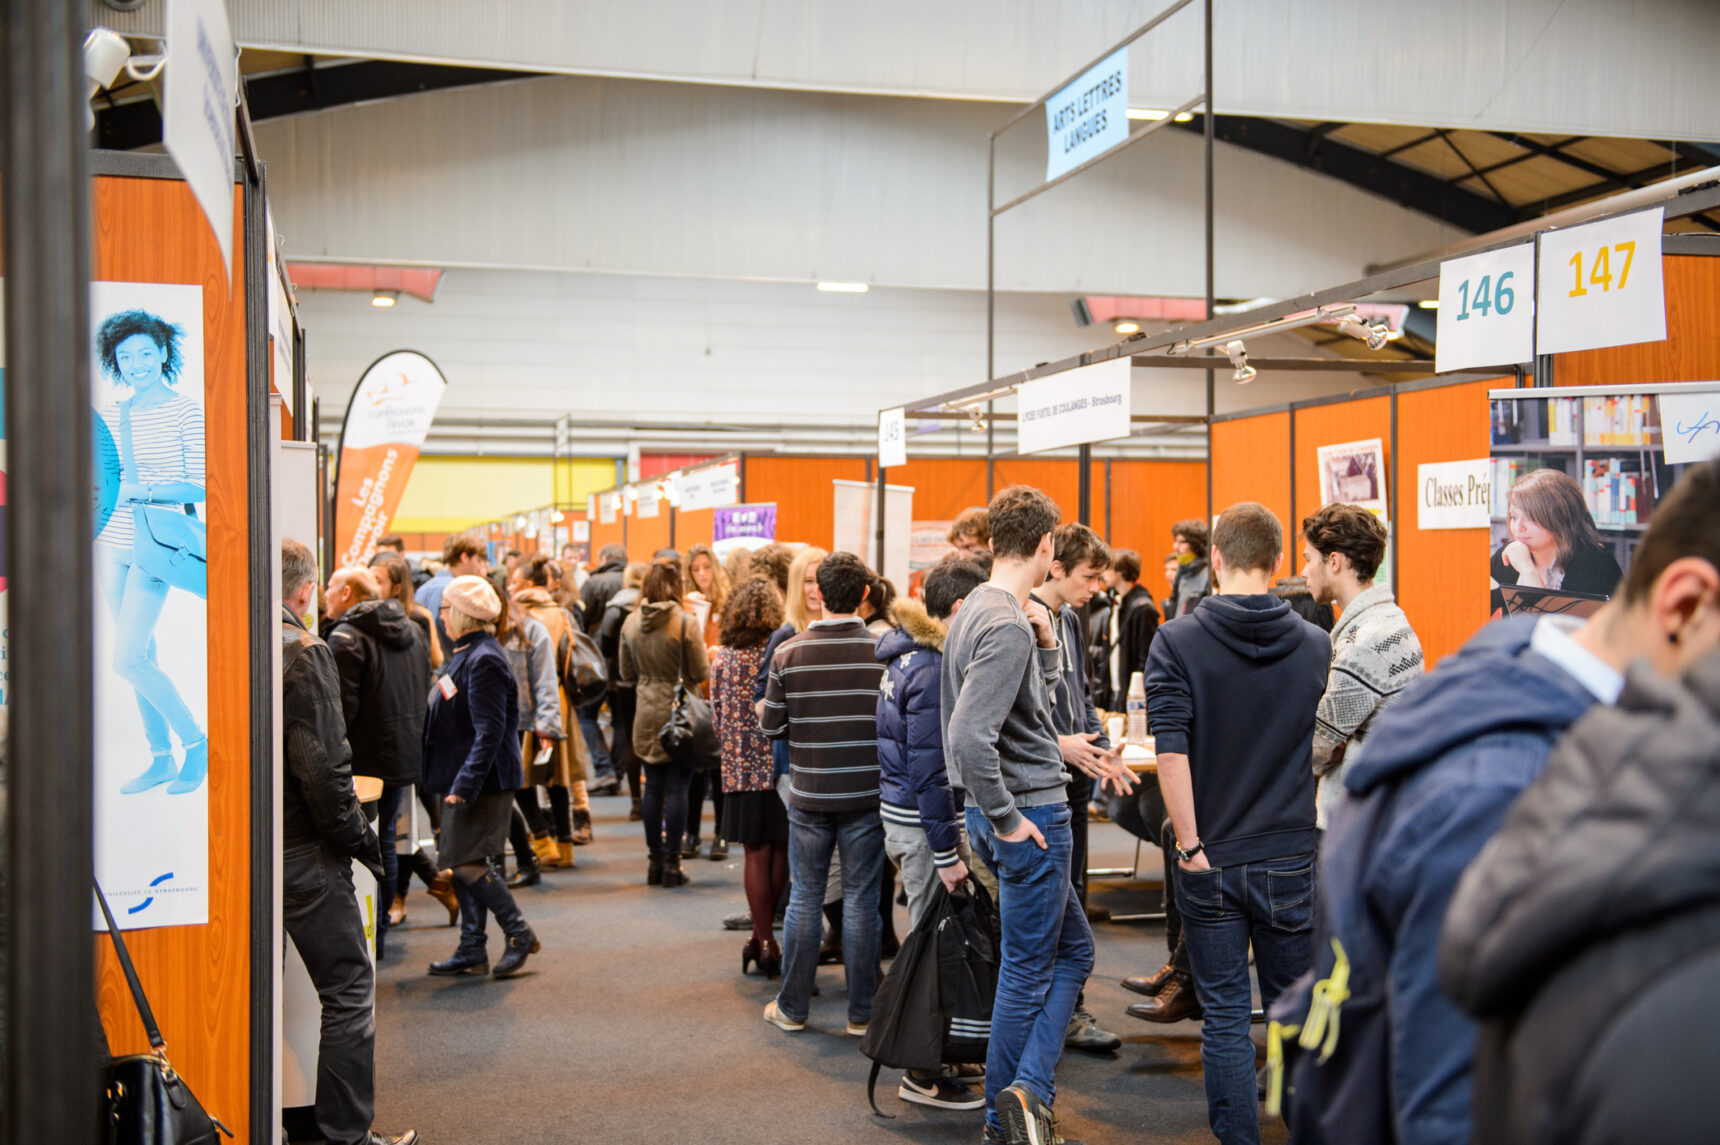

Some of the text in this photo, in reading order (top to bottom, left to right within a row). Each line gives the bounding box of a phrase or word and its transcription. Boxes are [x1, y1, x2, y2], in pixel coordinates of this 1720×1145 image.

[1053, 69, 1122, 134] ARTS LETTRES
[1063, 108, 1109, 154] LANGUES
[1569, 240, 1636, 298] 147
[1456, 271, 1515, 322] 146
[1091, 393, 1123, 407] Strasbourg
[341, 447, 399, 568] Compagnons
[352, 476, 375, 508] Les
[1425, 476, 1464, 508] Classes
[356, 510, 389, 567] Devoir
